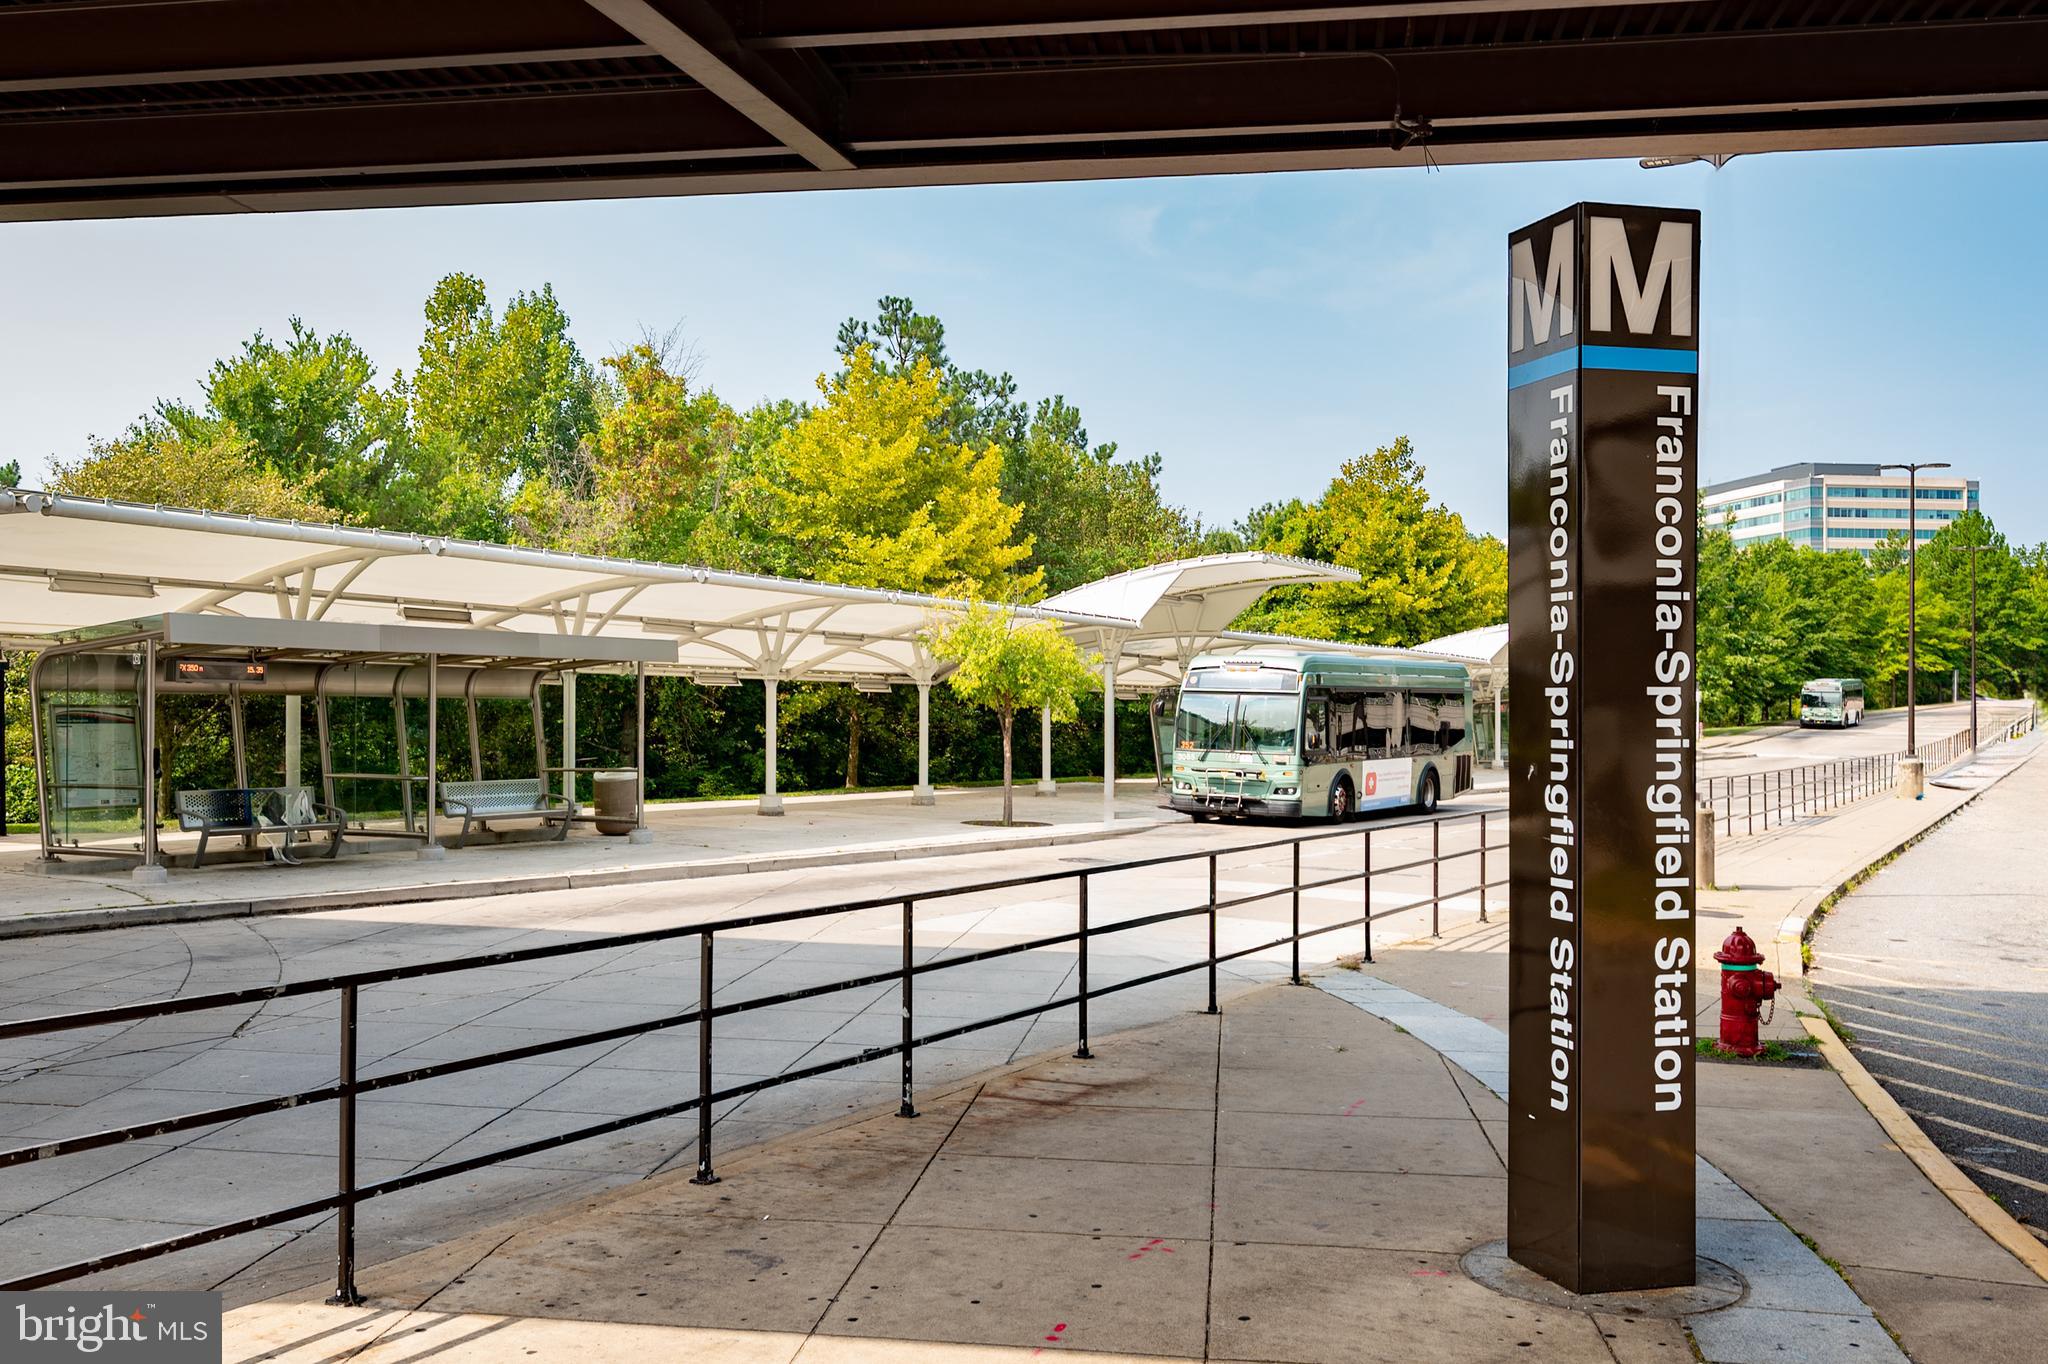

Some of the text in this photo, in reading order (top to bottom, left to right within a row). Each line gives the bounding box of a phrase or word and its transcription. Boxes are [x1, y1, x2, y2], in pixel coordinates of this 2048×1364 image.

[1511, 219, 1574, 354] M
[1590, 216, 1693, 336] M
[1545, 384, 1574, 1112] Franconia-Springfield Station
[1646, 385, 1691, 1112] Franconia-Springfield Station
